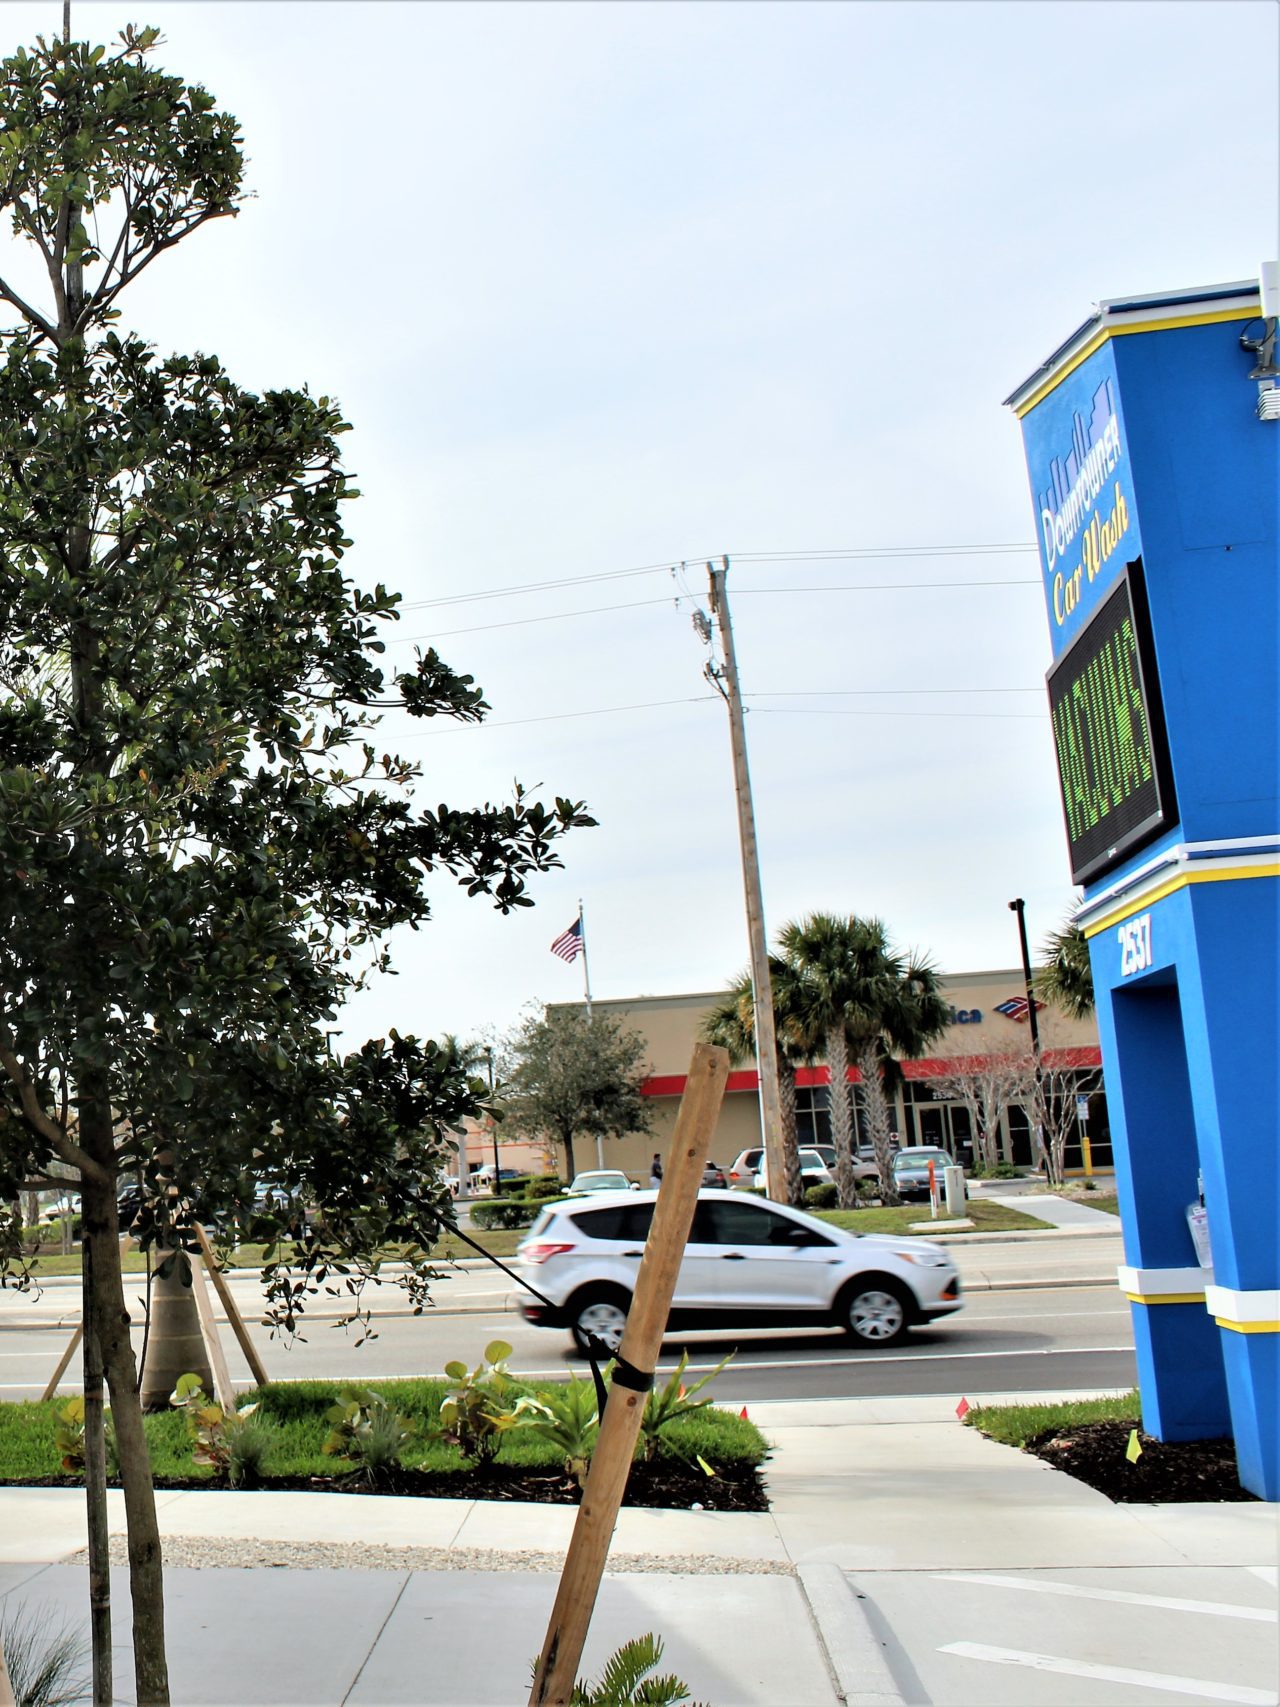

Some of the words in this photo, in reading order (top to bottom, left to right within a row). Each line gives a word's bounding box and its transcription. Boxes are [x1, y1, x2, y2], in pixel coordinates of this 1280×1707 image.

[1053, 572, 1082, 626] Car
[1082, 480, 1129, 583] Wash
[1052, 616, 1152, 842] VACUUMS
[1118, 913, 1153, 976] 2537
